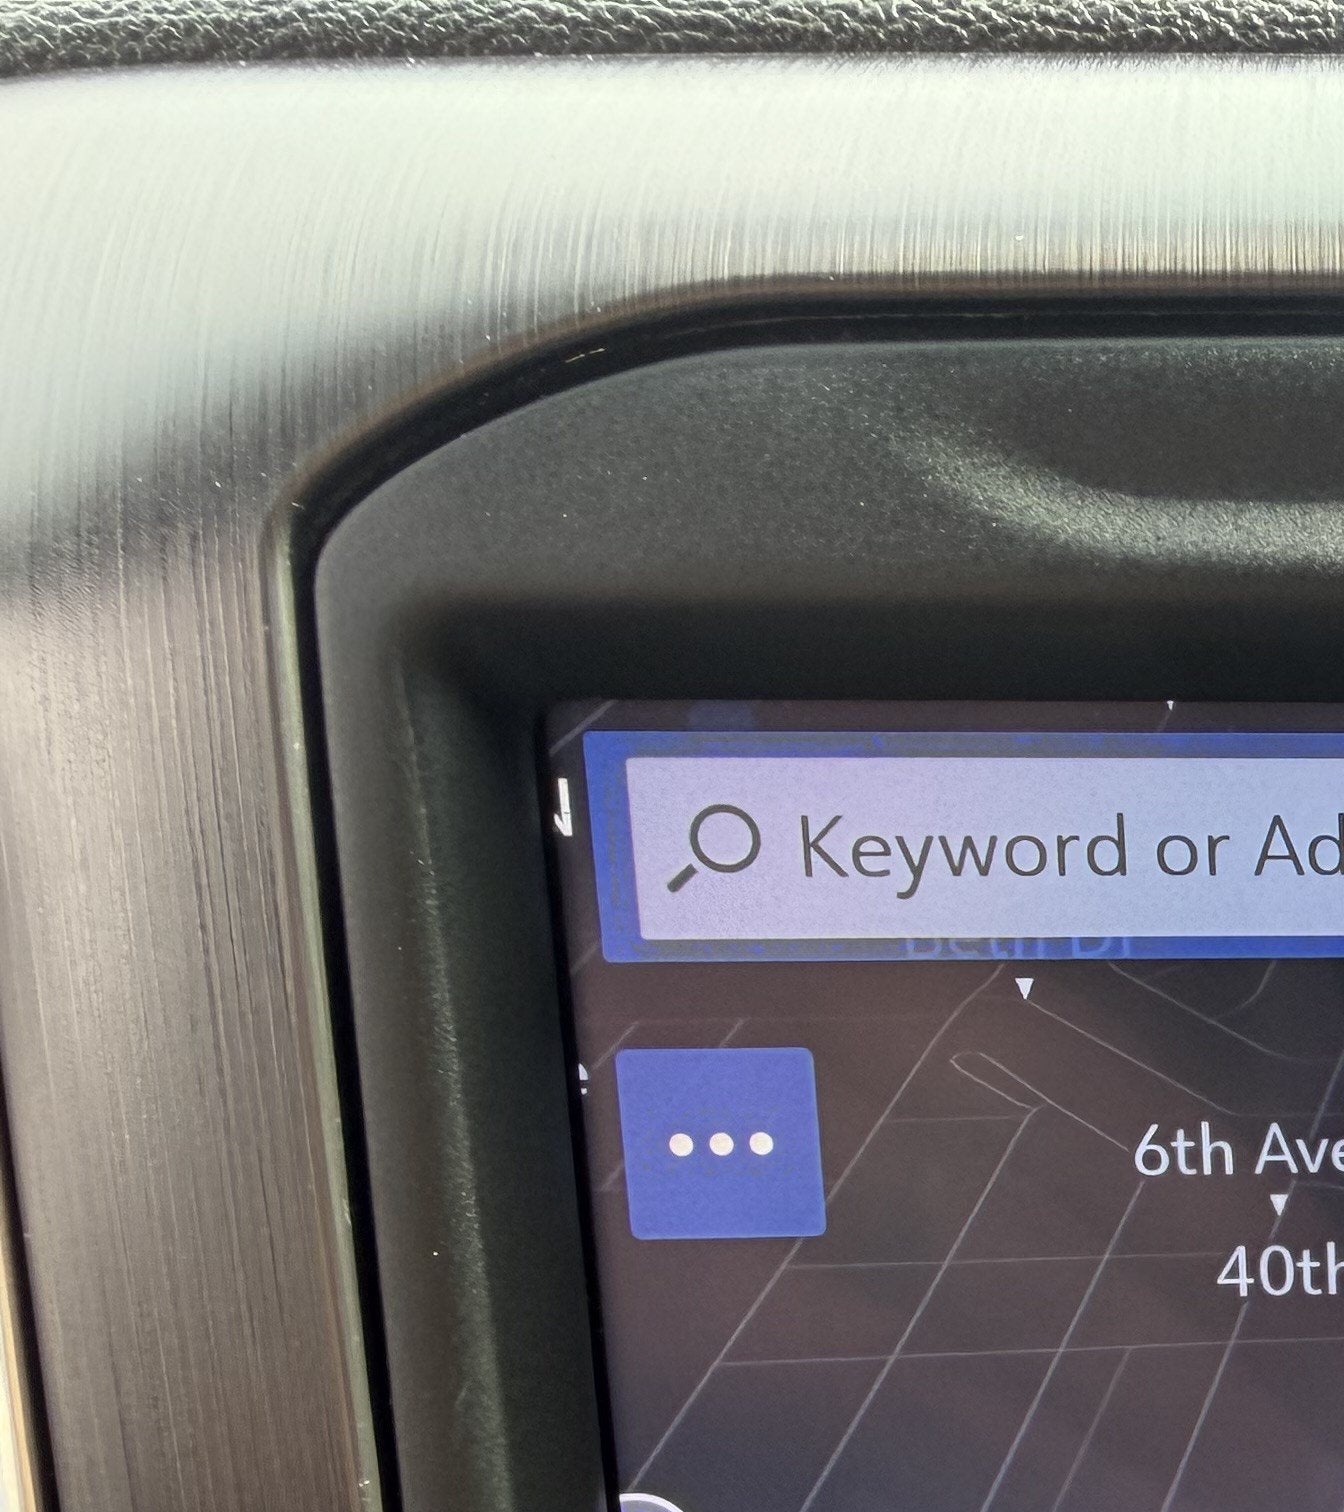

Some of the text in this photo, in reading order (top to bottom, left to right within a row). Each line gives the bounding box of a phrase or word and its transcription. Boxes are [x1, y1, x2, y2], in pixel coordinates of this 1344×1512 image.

[800, 812, 1127, 900] Keyword
[1156, 834, 1231, 877] or
[1134, 1120, 1234, 1176] 6th
